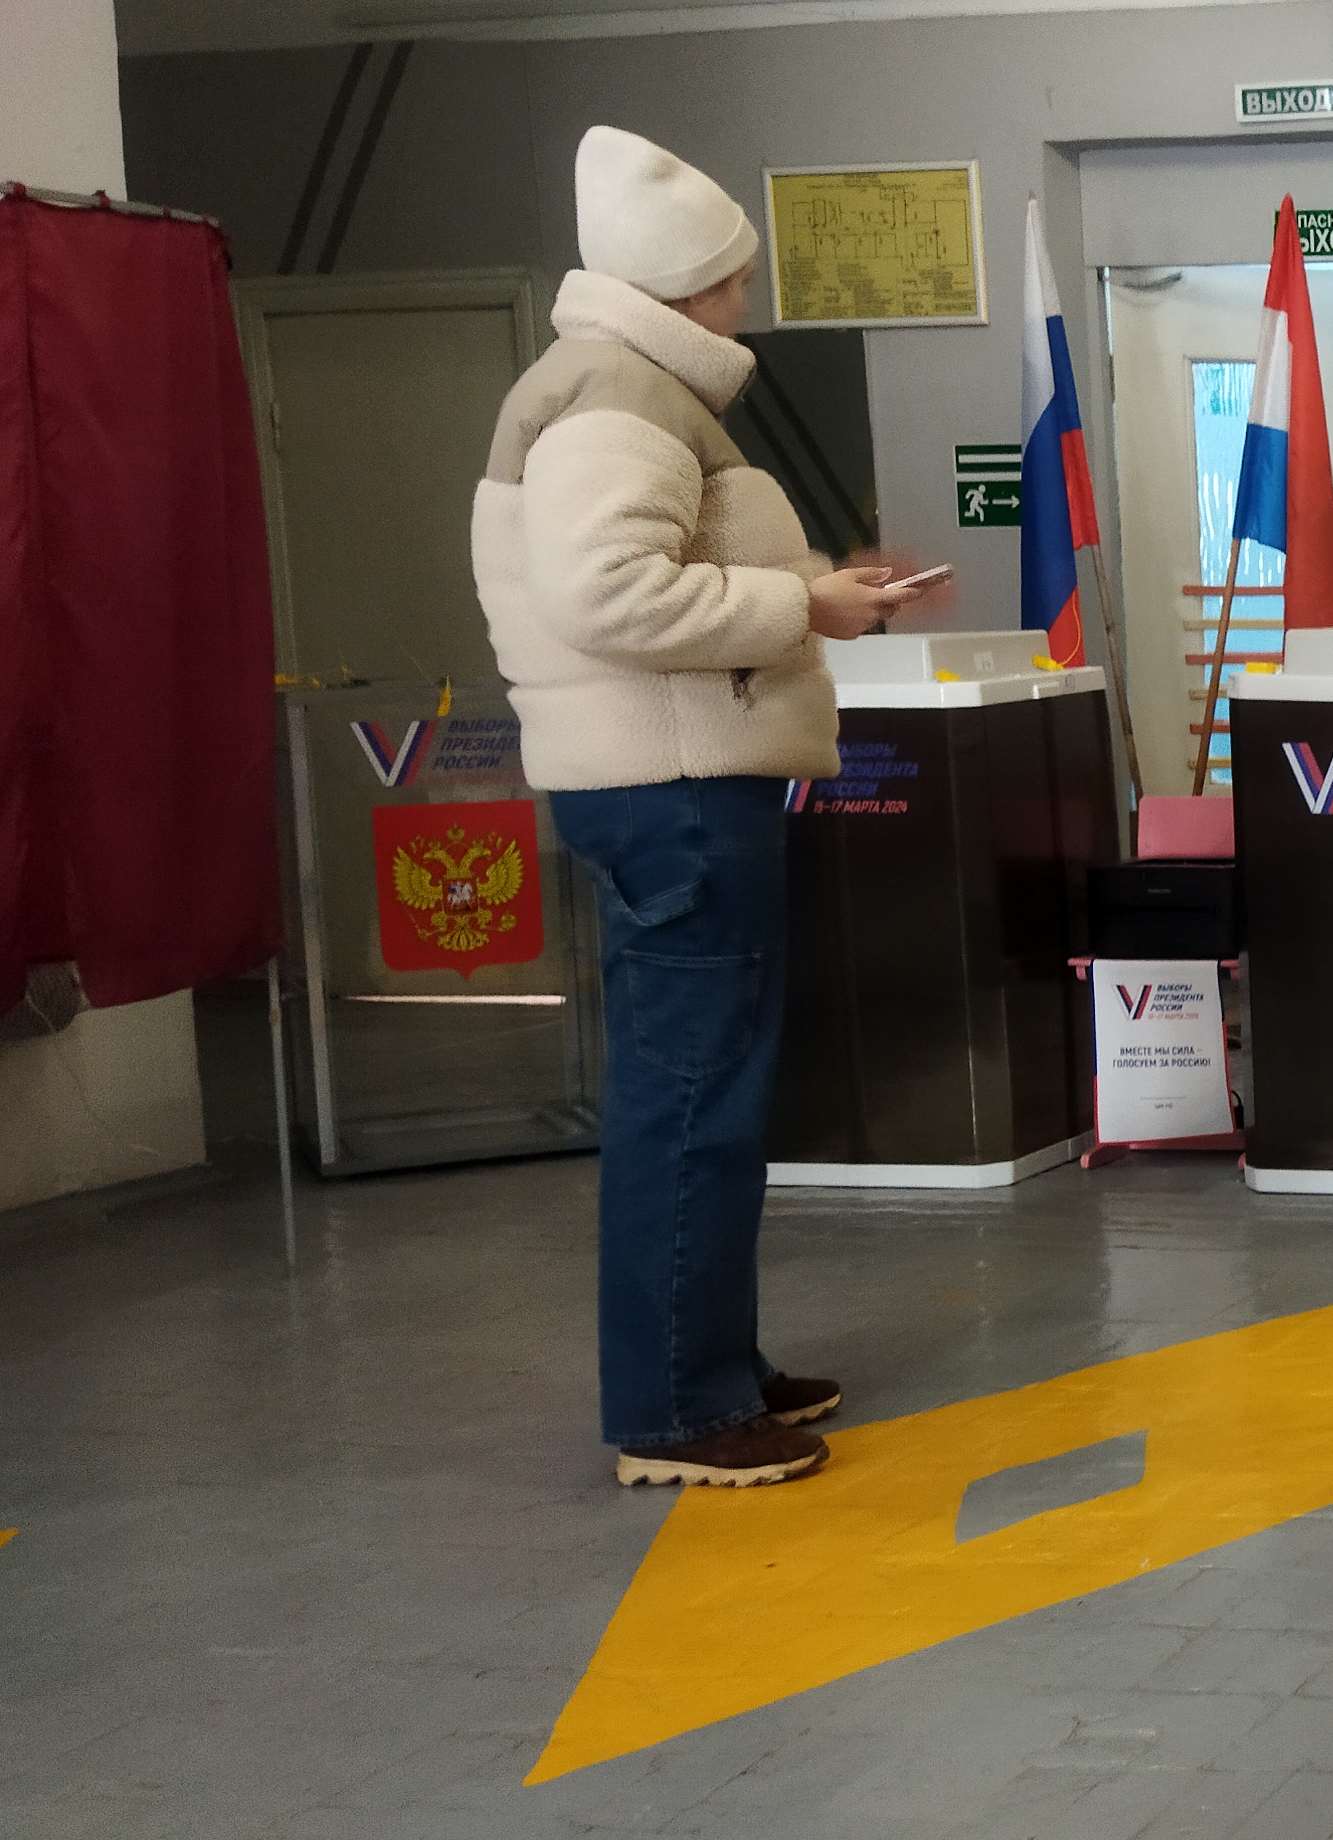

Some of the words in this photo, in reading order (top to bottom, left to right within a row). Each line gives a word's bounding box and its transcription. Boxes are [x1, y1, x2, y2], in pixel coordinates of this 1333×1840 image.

[1245, 88, 1331, 114] ВЫХОД
[440, 736, 521, 752] ПРЕЗИДЕ
[432, 755, 501, 770] РОССИИ
[842, 800, 880, 814] МАРТА
[881, 800, 908, 814] 2024
[1153, 994, 1204, 1002] ПРЕЗИДЕНТА
[1150, 1004, 1183, 1012] РОССИИ
[1120, 1047, 1151, 1055] ВМЕСТЕ
[1154, 1047, 1170, 1055] МЫ
[1172, 1046, 1195, 1055] СИЛА
[1112, 1059, 1157, 1068] ГОЛОСУЕМ
[1159, 1059, 1169, 1067] ЗА
[1171, 1058, 1211, 1067] РОССИЮ!
